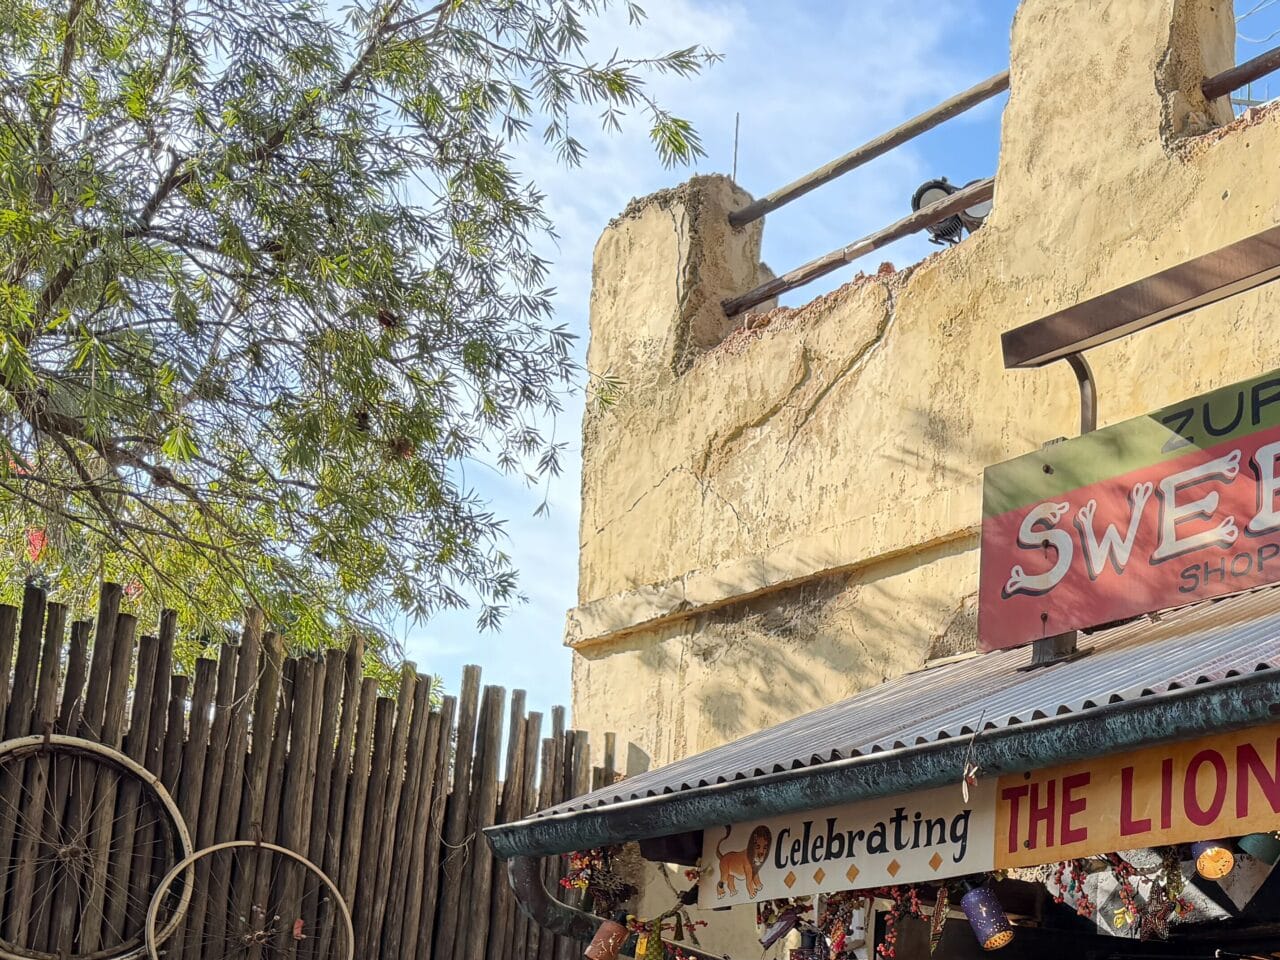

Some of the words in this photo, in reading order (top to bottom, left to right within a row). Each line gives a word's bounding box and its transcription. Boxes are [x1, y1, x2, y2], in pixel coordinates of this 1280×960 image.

[1178, 543, 1280, 594] SHOP
[775, 807, 972, 863] Celebrating
[1002, 772, 1091, 854] THE
